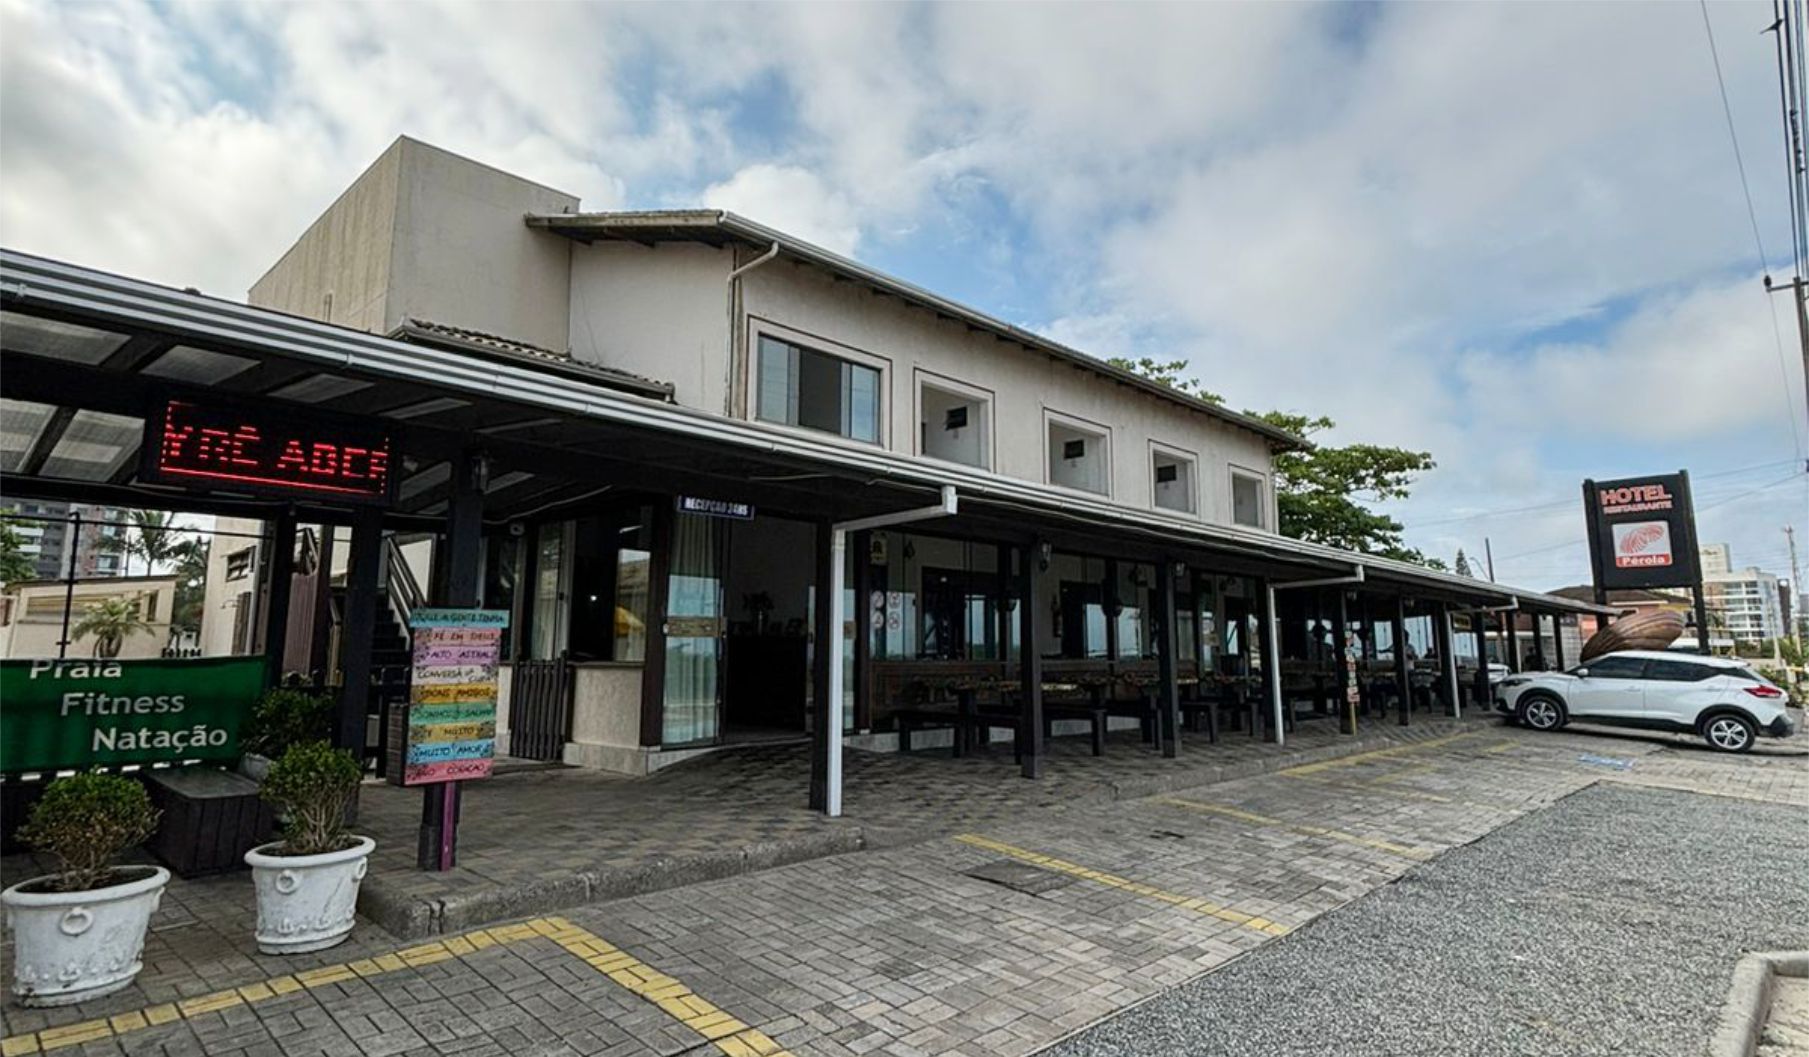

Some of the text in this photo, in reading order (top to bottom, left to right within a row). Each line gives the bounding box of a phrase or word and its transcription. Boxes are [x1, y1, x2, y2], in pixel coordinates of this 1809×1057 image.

[1600, 484, 1673, 505] HOTEL
[1603, 500, 1673, 514] RESTAURANTE
[1622, 555, 1665, 566] Pérola
[30, 659, 122, 679] Praia
[61, 692, 185, 716] Fitness
[92, 725, 228, 753] Natação
[444, 727, 475, 736] MUITO
[419, 747, 450, 756] MUITO
